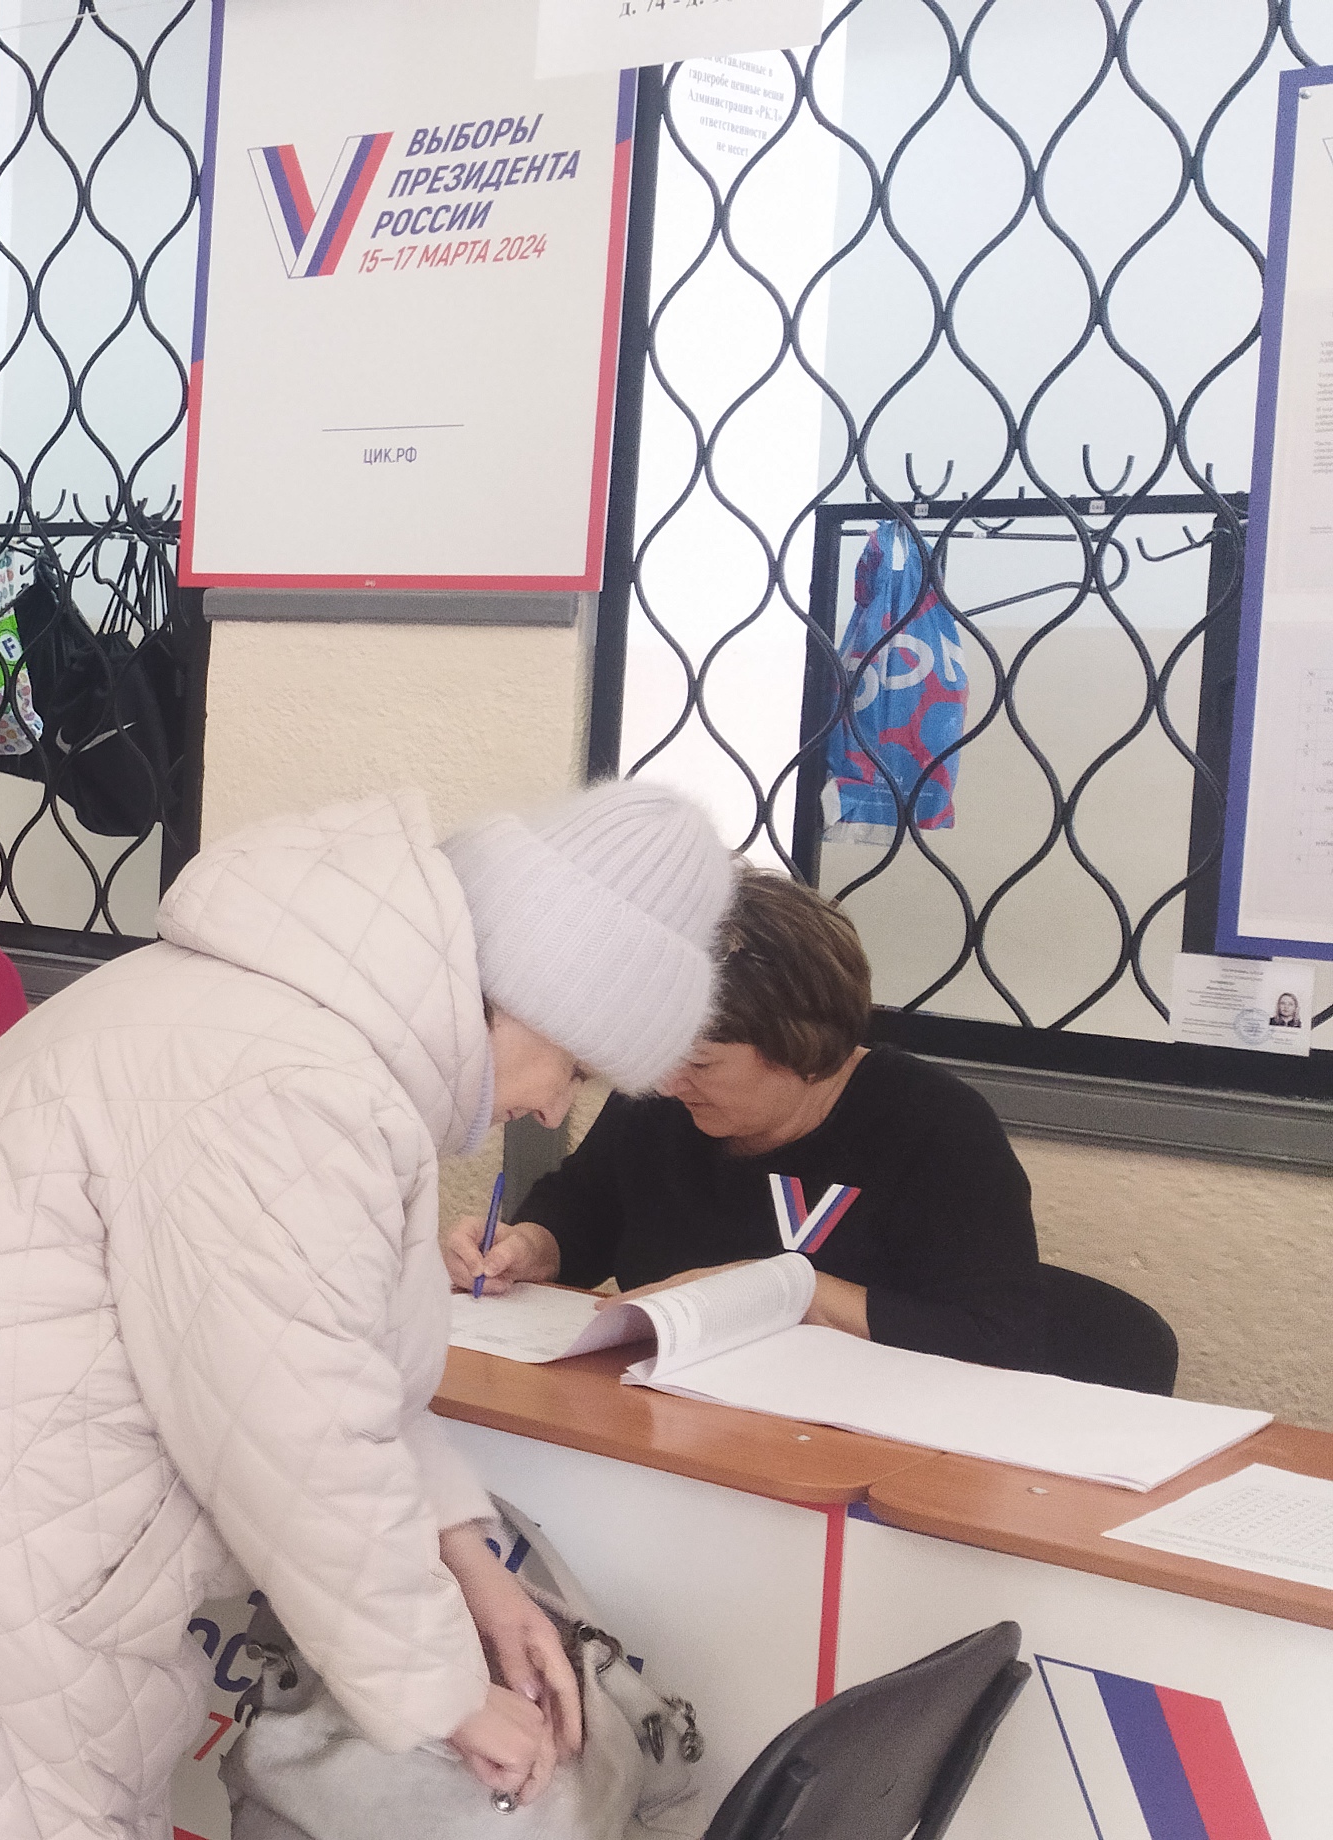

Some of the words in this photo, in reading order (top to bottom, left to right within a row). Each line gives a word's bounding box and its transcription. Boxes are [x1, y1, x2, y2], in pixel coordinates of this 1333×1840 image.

[689, 68, 729, 88] гардеробе
[731, 78, 762, 96] ценные
[687, 89, 754, 115] Администрация
[405, 113, 544, 158] ВЫБОРЫ
[700, 117, 767, 141] ответственности
[716, 140, 726, 151] не
[388, 150, 581, 199] ПРЕЗИДЕНТА
[370, 200, 494, 239] РОССИИ
[417, 239, 492, 269] МАРТА
[492, 233, 548, 262] 2024
[363, 446, 417, 465] ЦИК.РФ
